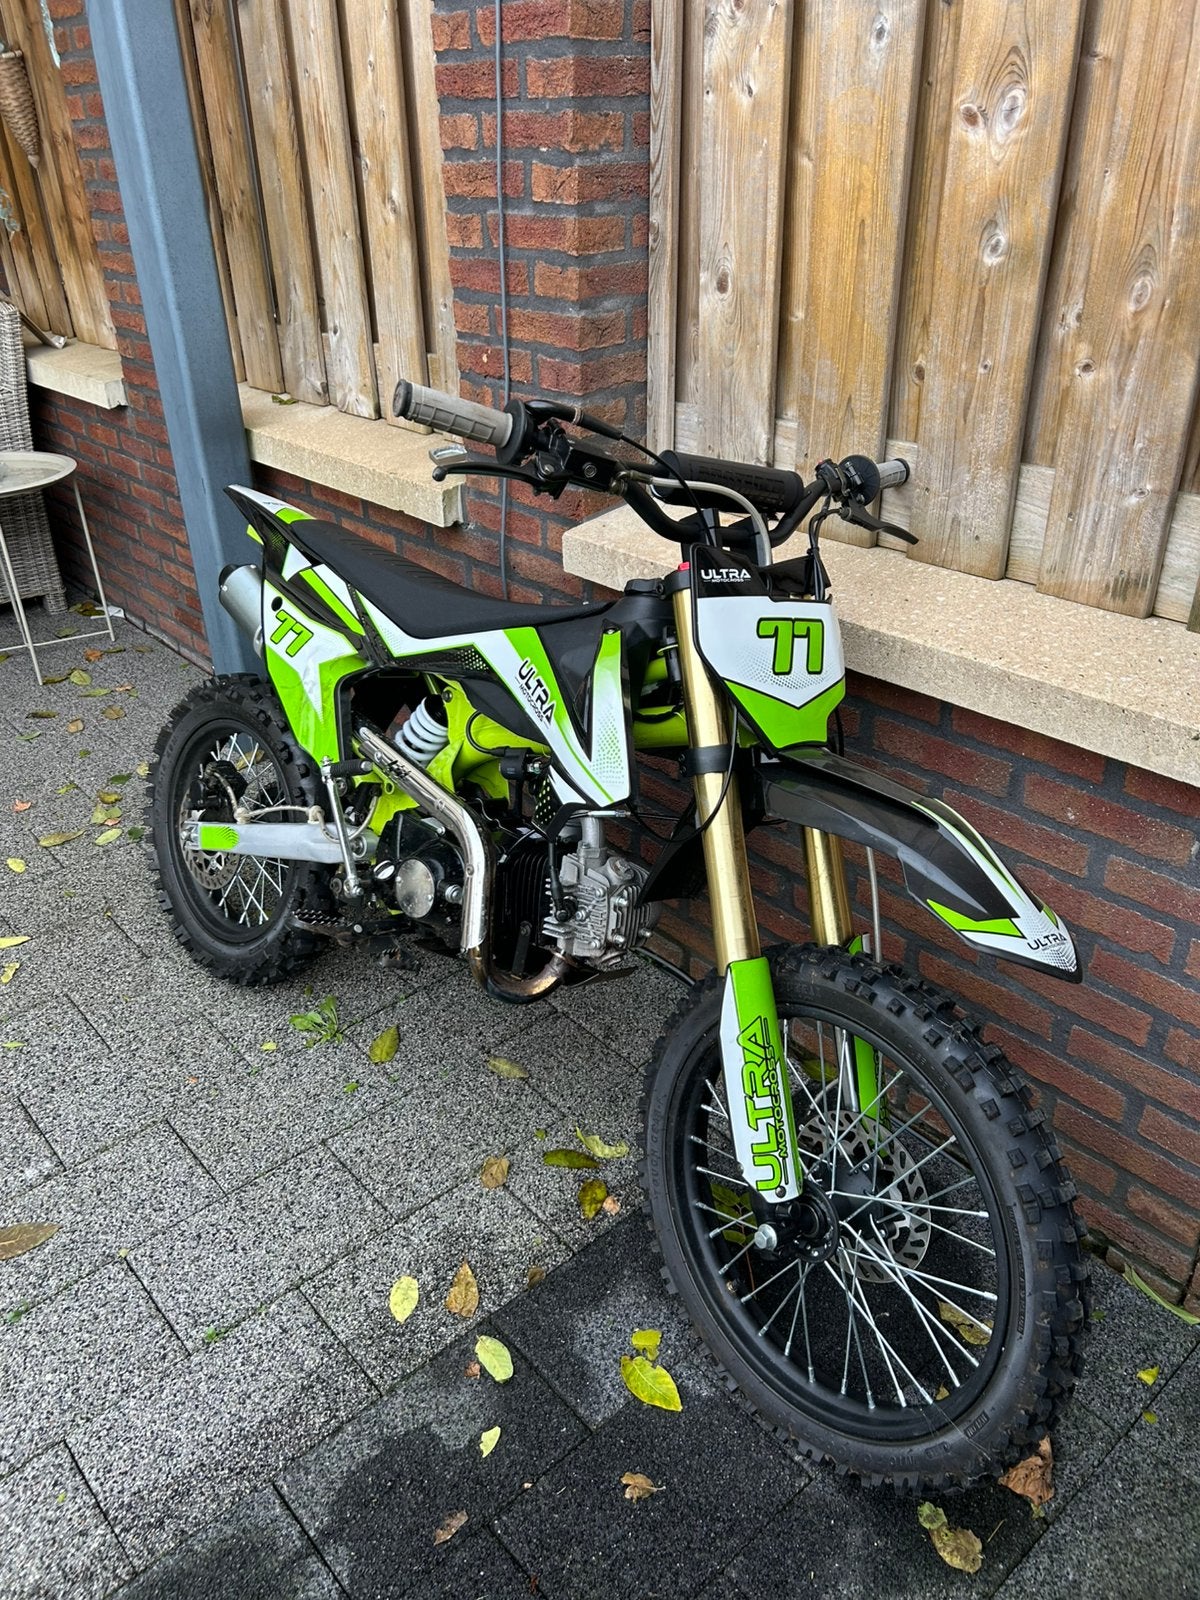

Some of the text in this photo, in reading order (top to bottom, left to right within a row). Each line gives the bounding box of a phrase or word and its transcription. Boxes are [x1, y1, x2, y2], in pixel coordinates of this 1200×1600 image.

[701, 568, 751, 580] ULTRA
[270, 609, 314, 658] 77
[756, 617, 825, 675] 77
[518, 660, 555, 725] ULTRA
[1027, 932, 1067, 950] ULTRA
[737, 1015, 783, 1191] ULTRA
[764, 1044, 788, 1159] MOTOCROSS
